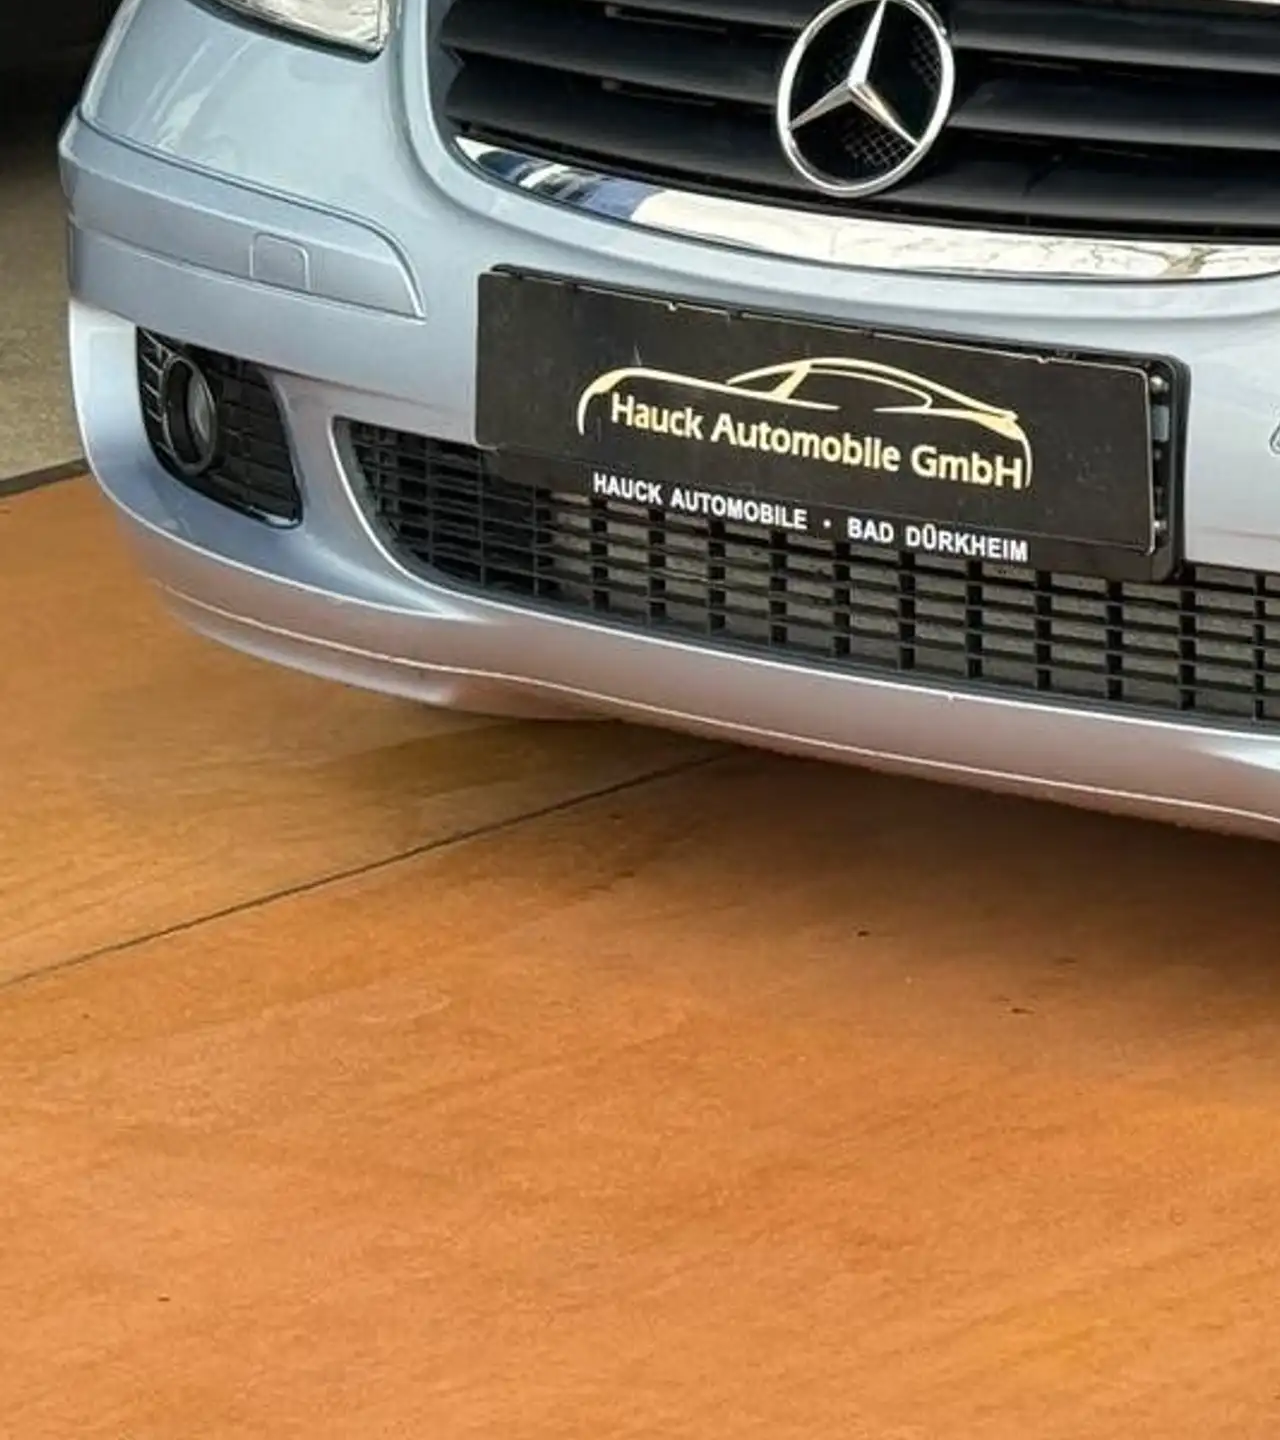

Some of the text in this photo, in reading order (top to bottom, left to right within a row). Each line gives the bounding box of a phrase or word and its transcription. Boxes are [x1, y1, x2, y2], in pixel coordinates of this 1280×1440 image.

[610, 393, 1024, 490] Hauck Automobile GmbH
[593, 471, 1029, 562] HAUCK AUTOMOBILE BAD DÜRKHEIM
